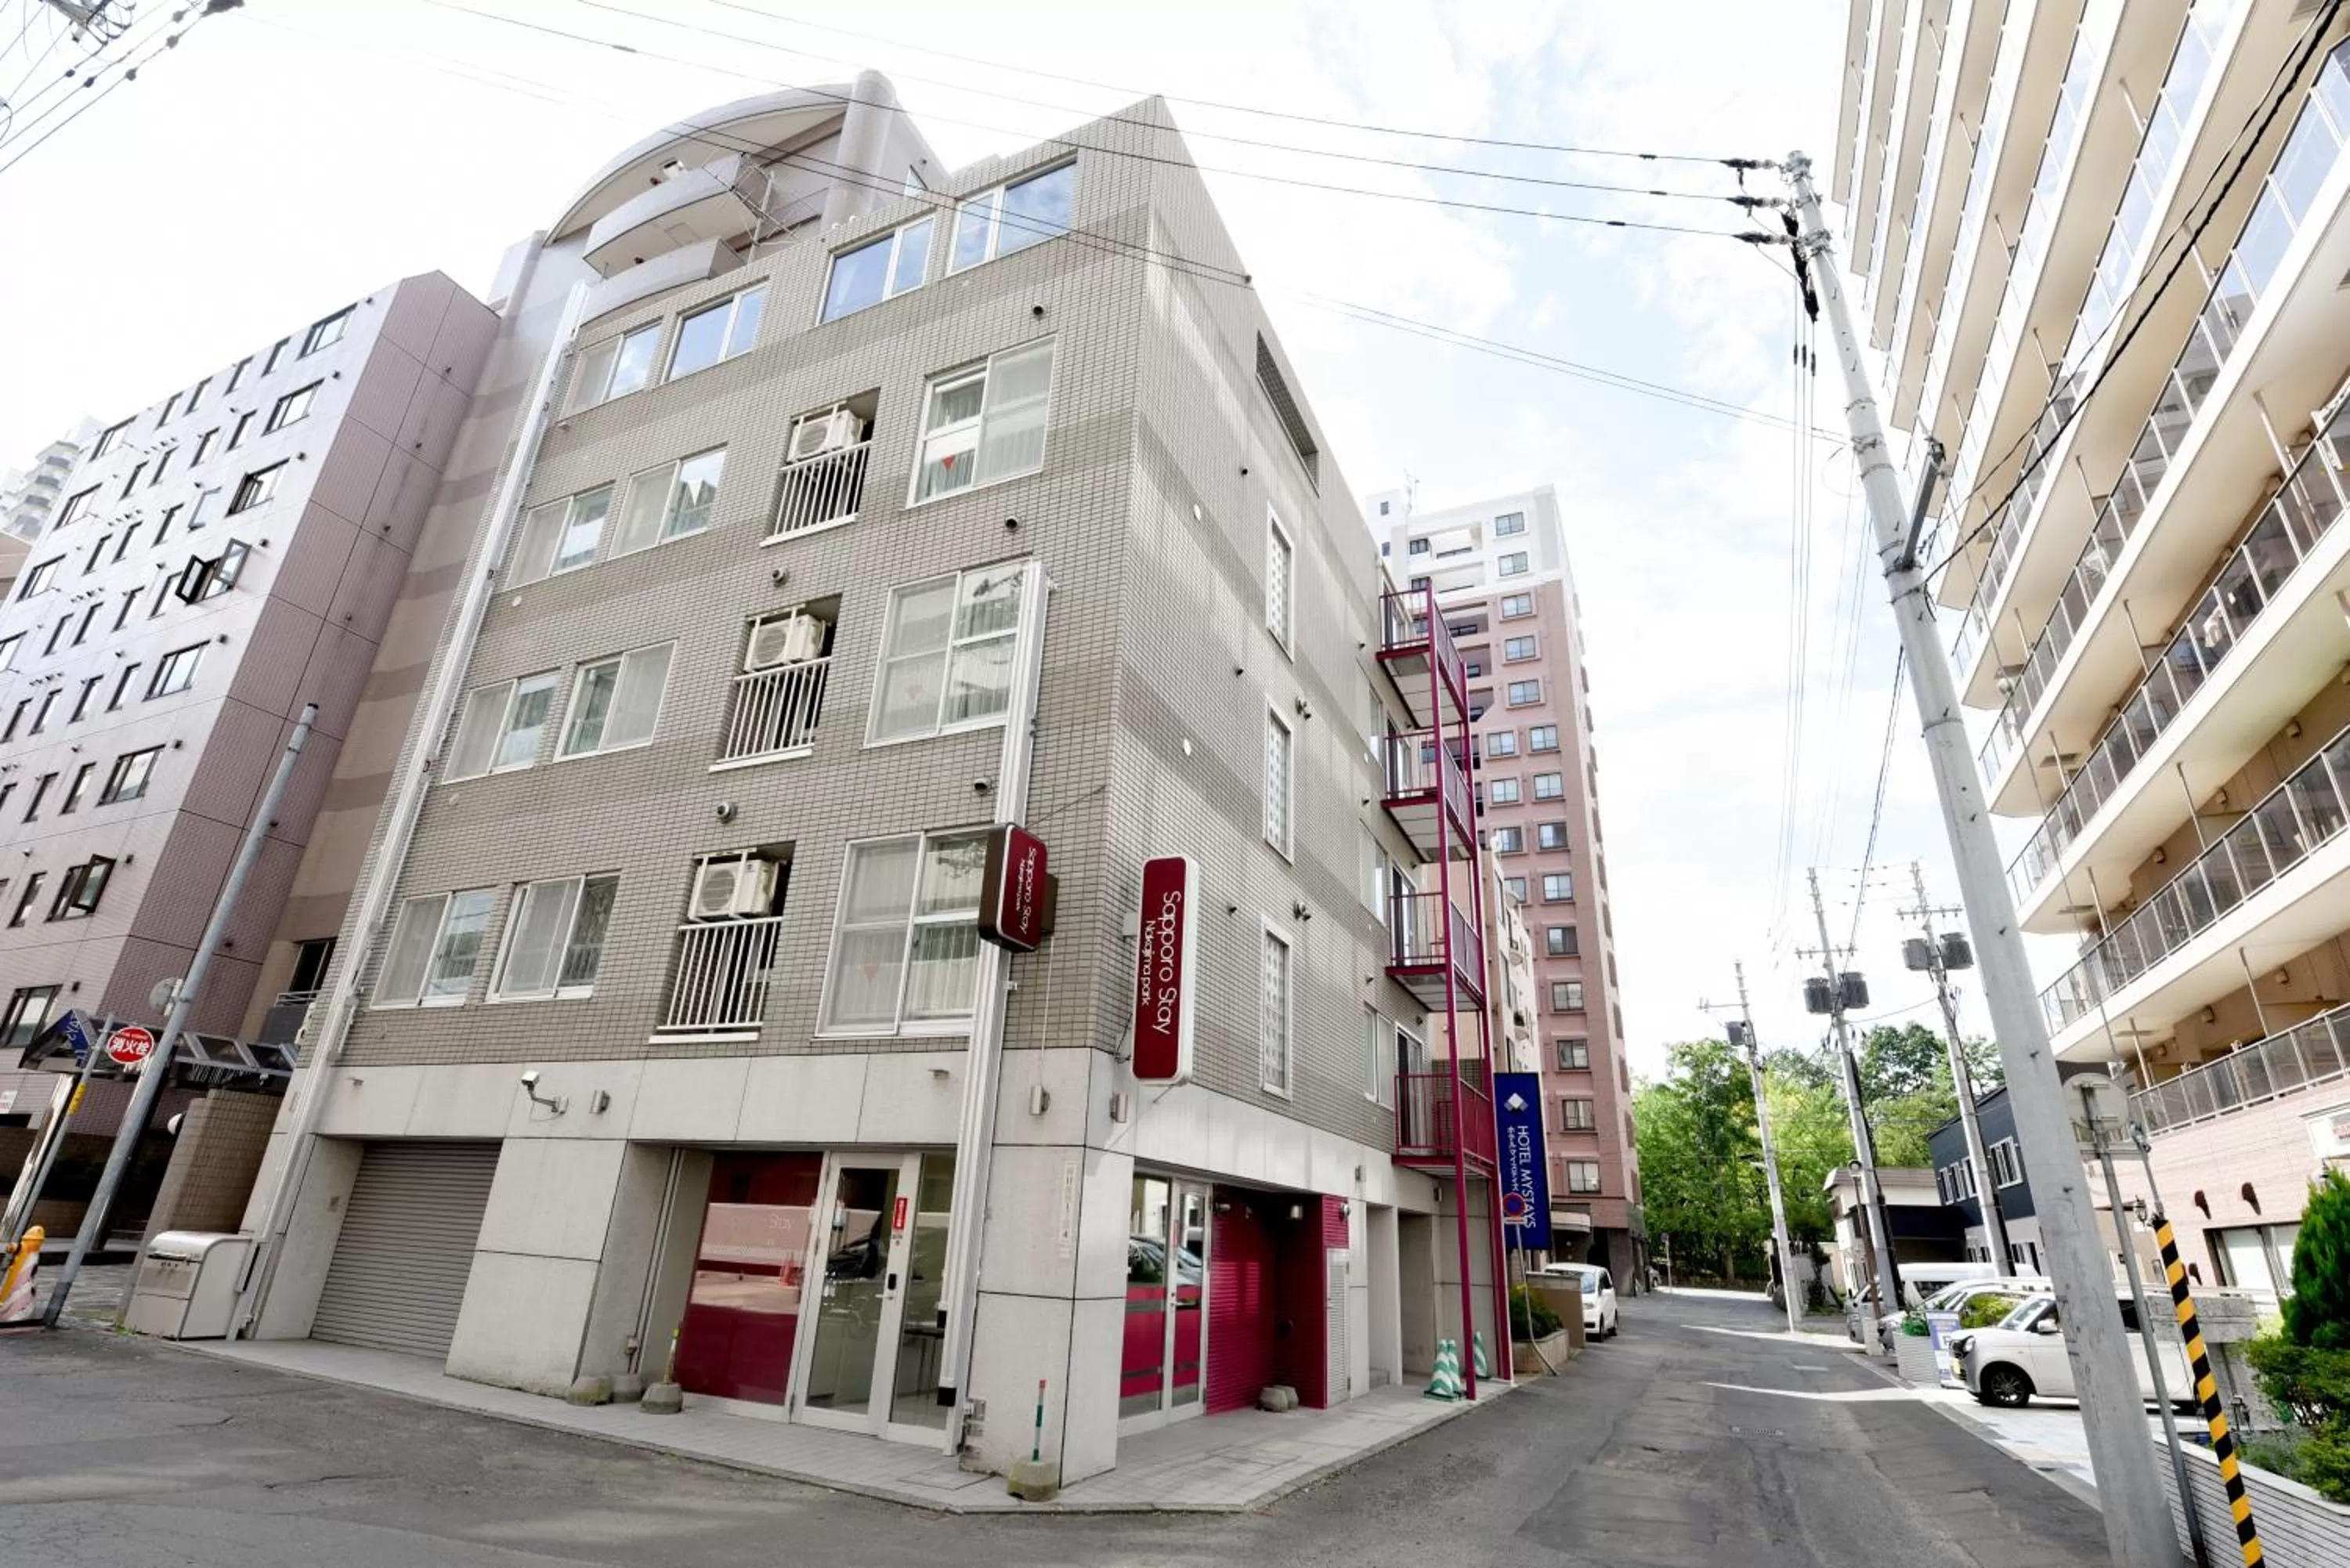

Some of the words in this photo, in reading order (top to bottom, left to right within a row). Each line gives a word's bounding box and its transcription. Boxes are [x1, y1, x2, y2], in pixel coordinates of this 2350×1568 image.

[1019, 905, 1032, 934] Stay
[1157, 891, 1182, 982] Sapporo
[1142, 919, 1156, 976] Nakajima
[1152, 987, 1177, 1035] Stay
[110, 1035, 151, 1056] 消火栓
[1517, 1125, 1531, 1165] HOTEL
[1520, 1168, 1537, 1229] MYSTAYS
